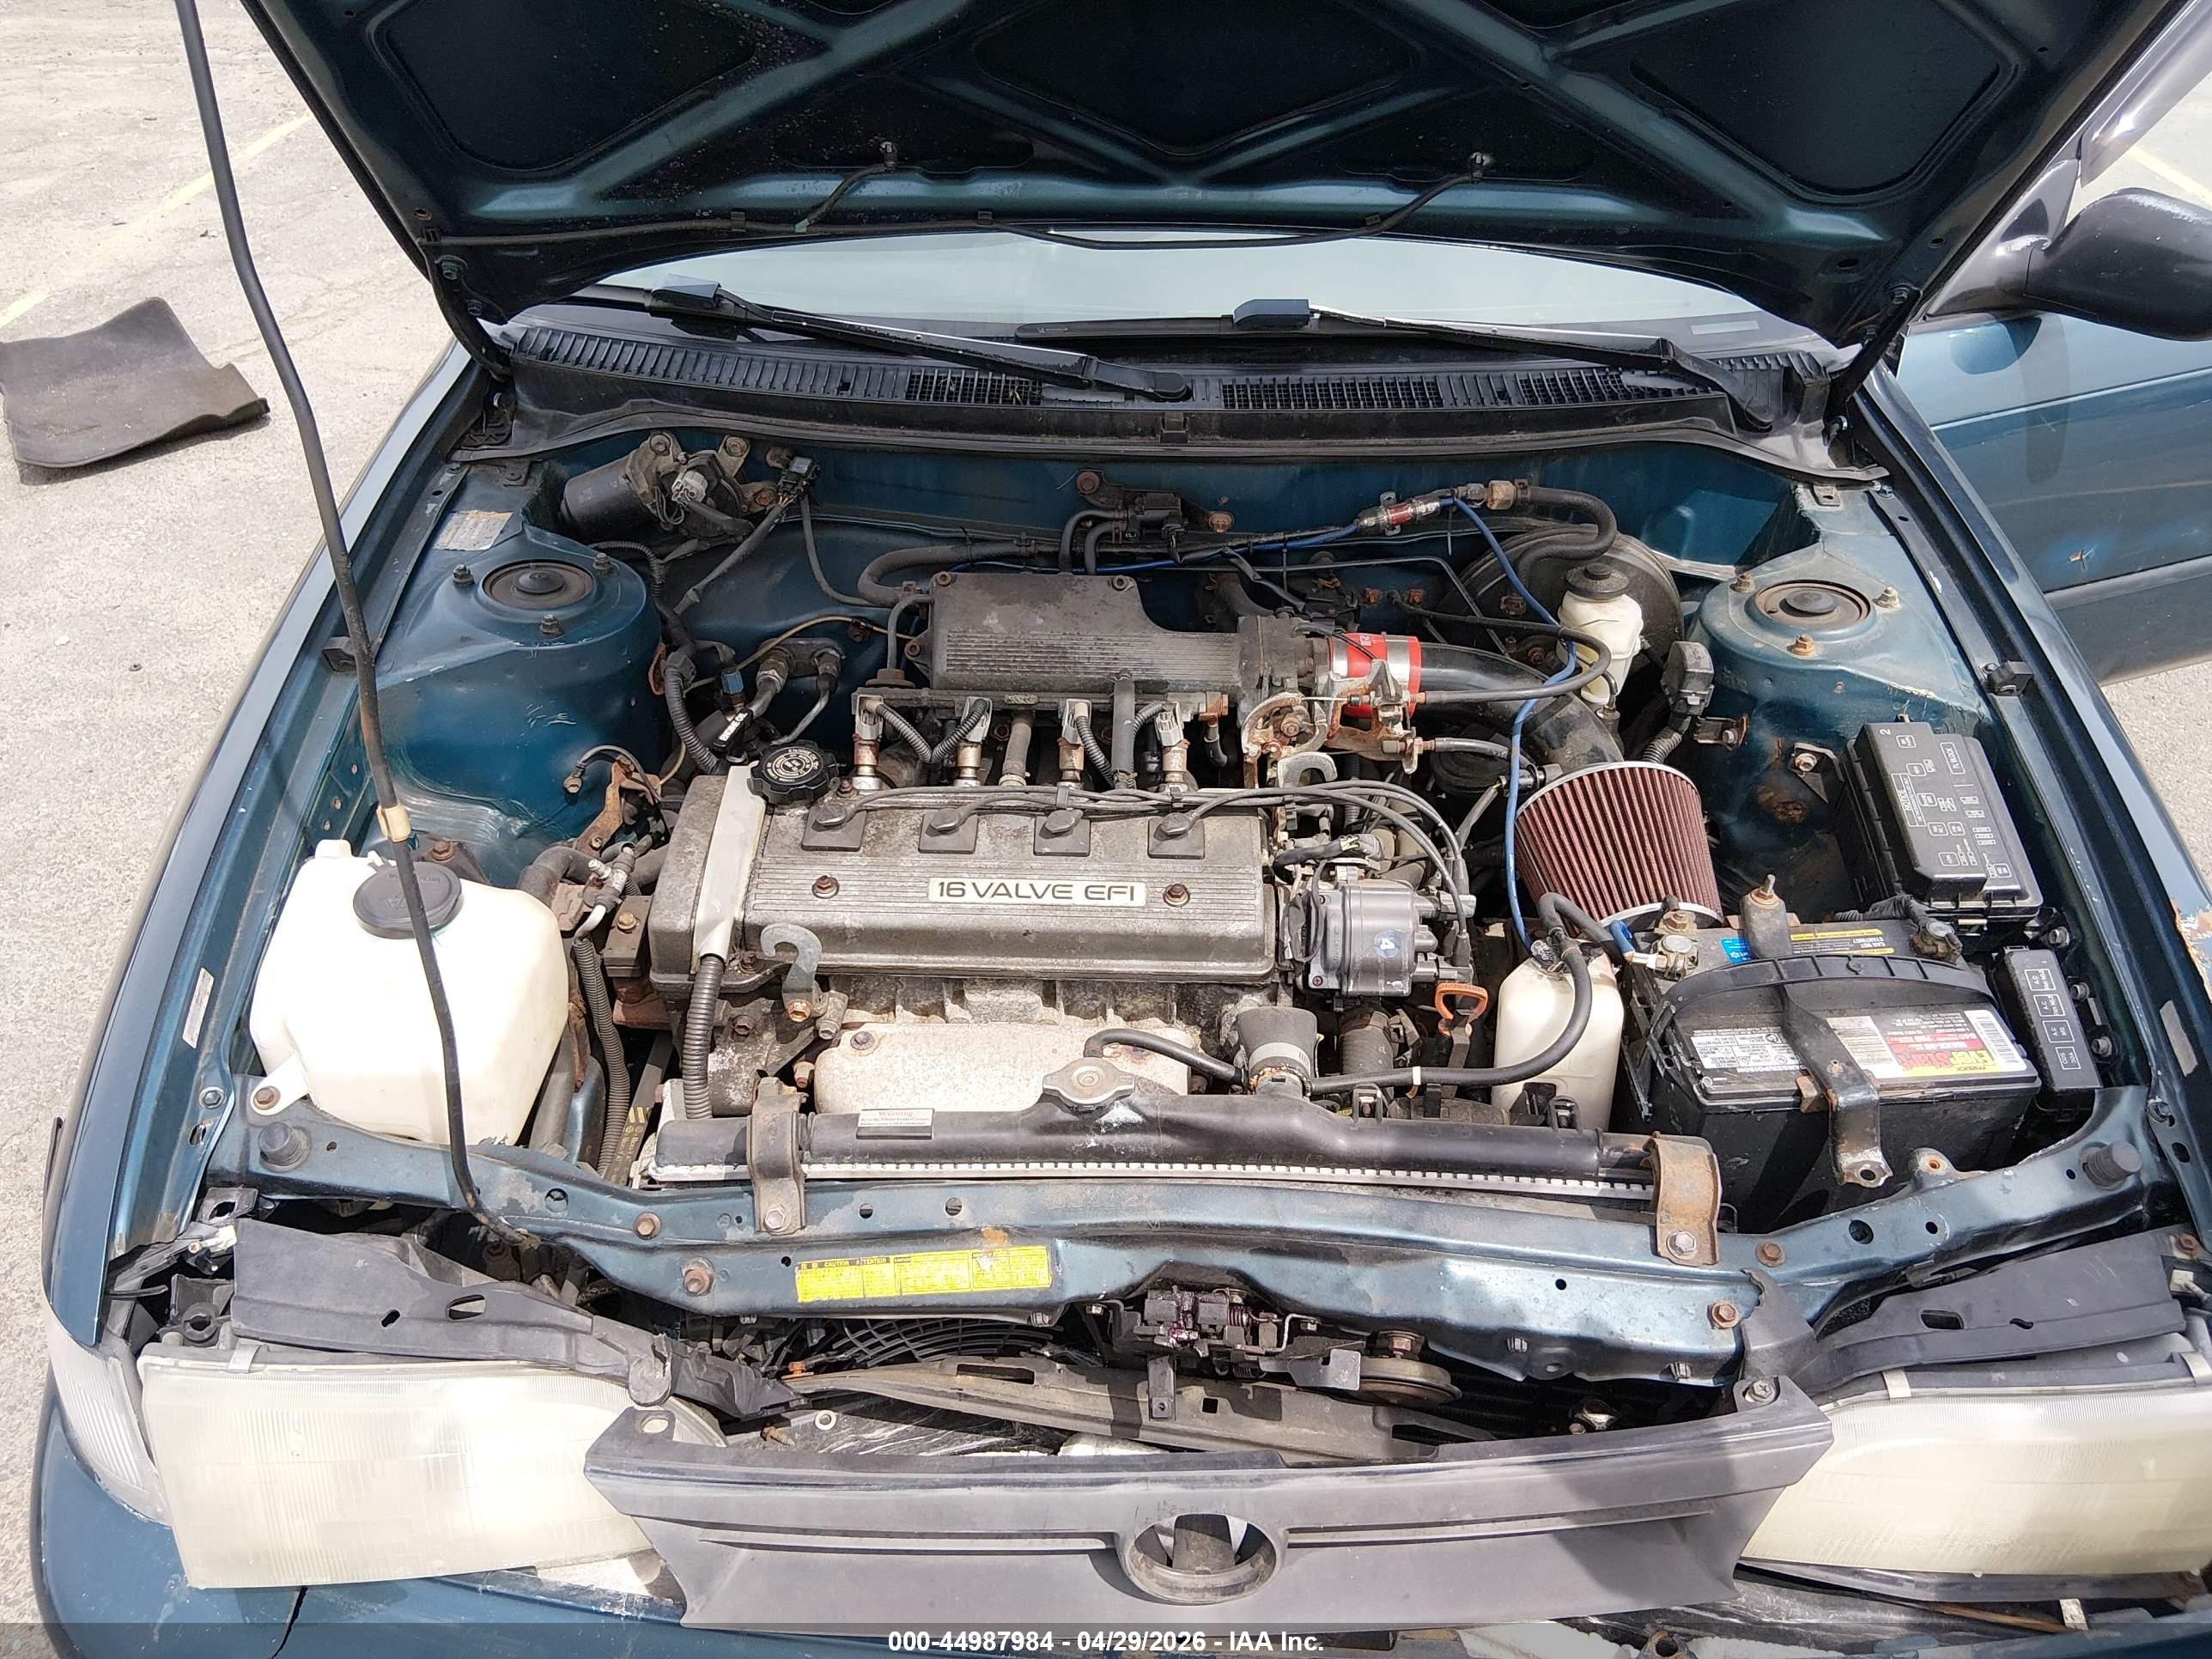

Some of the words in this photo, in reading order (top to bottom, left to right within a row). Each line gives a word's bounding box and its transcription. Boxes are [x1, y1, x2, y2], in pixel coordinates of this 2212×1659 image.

[939, 881, 966, 898] 16
[970, 882, 1073, 900] VALVE
[1084, 885, 1135, 902] EFI
